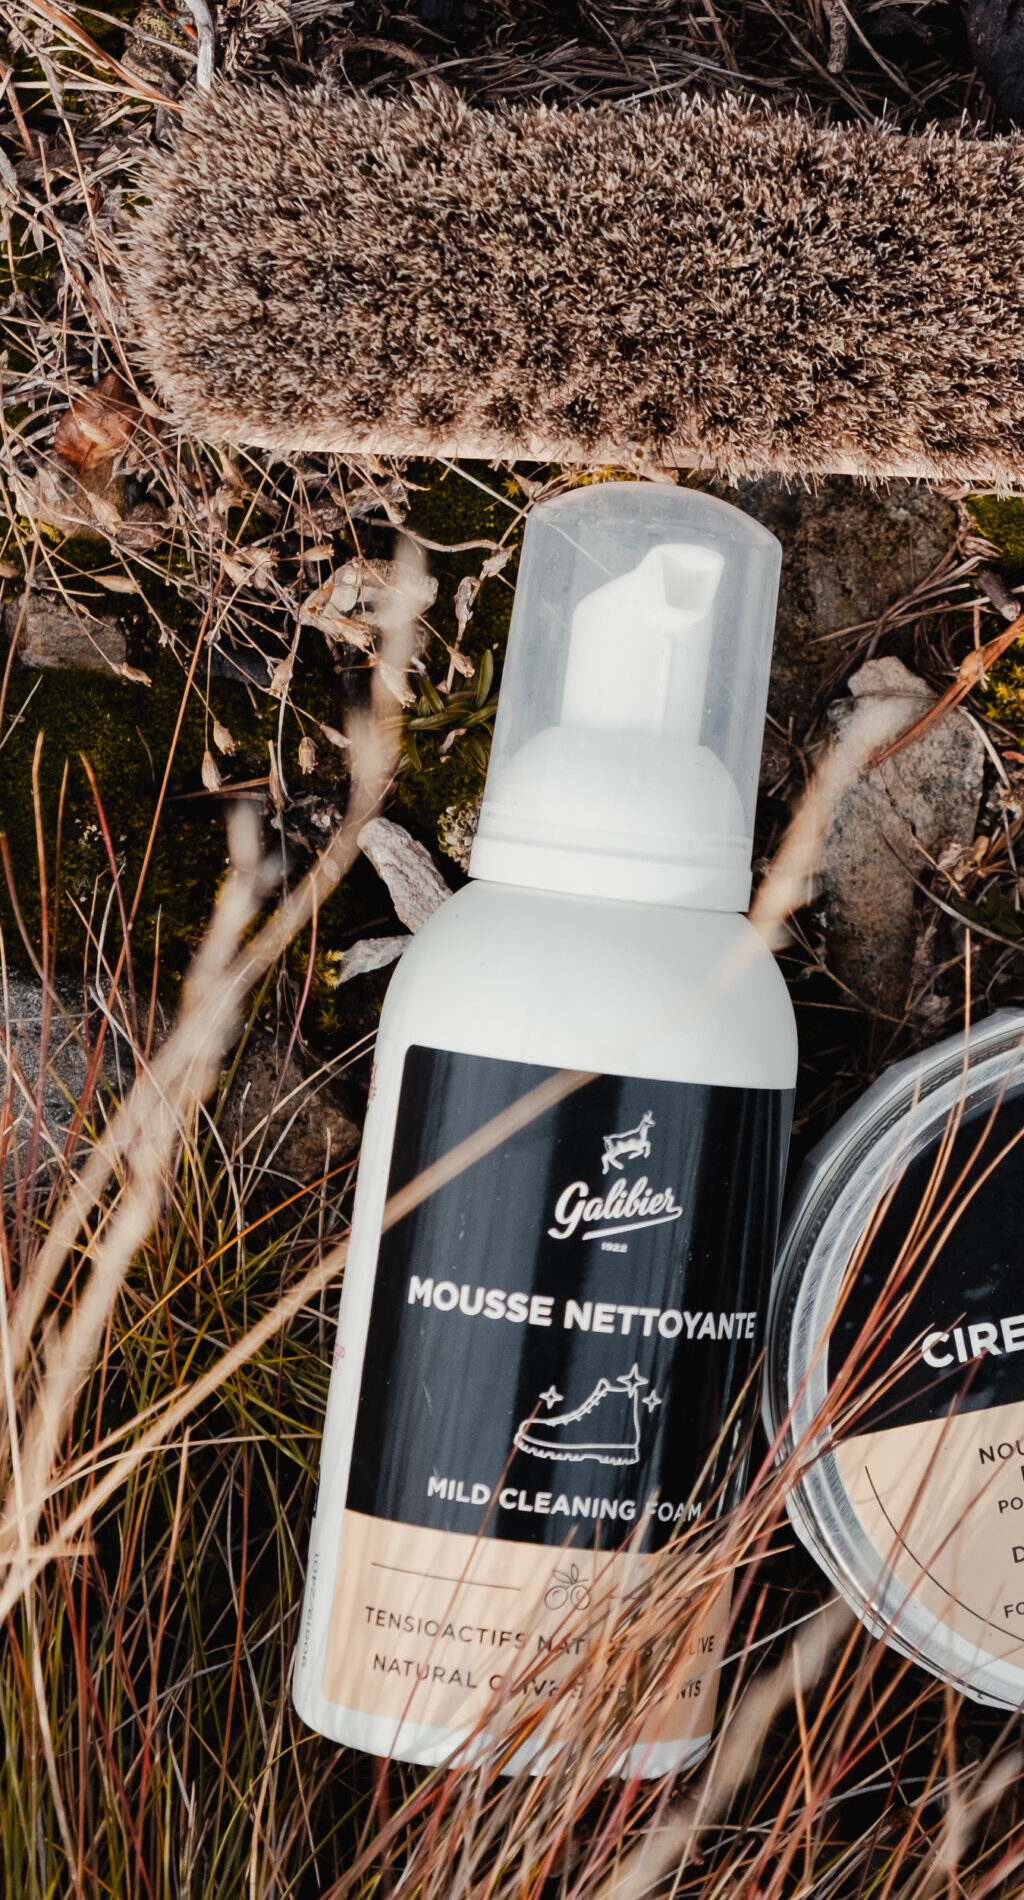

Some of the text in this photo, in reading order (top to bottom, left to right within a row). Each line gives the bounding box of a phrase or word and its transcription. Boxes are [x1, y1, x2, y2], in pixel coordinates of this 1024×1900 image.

[548, 1176, 684, 1240] Galibier
[601, 1242, 628, 1253] 1922
[407, 1275, 757, 1340] MOUSSE NETTOYANTE
[427, 1476, 702, 1522] MILD CLEANING FOAM
[365, 1606, 528, 1649] TENSIOACTIFS
[373, 1653, 477, 1688] NATURAL
